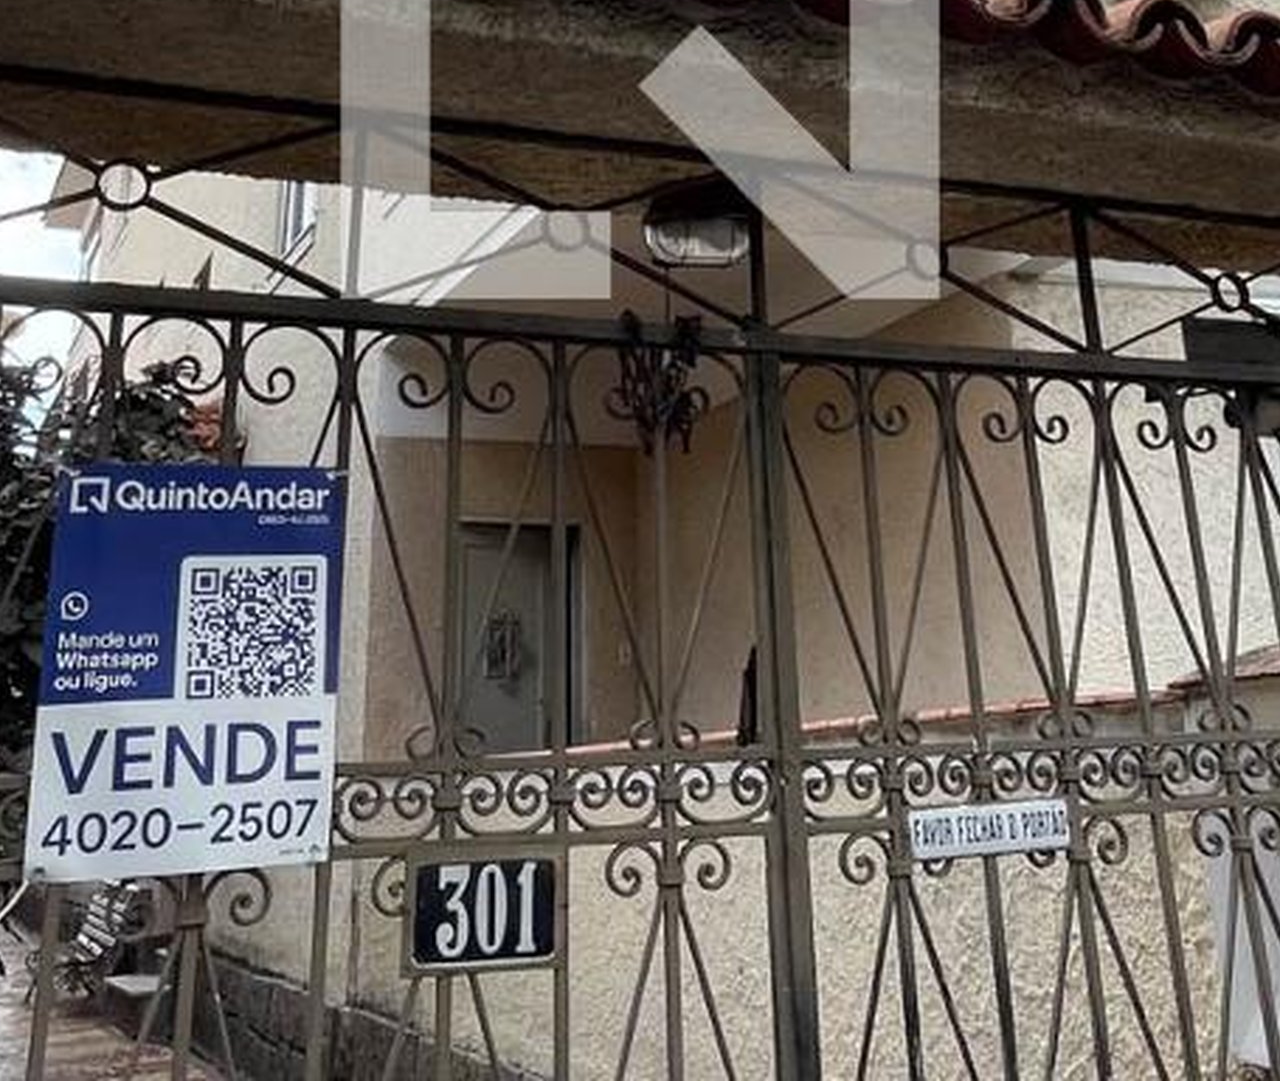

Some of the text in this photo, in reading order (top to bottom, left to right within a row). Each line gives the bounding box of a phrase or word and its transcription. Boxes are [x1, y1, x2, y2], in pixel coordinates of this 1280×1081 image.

[115, 480, 330, 512] QuintoAndar
[58, 630, 159, 650] Mande um
[55, 651, 159, 671] Whatsapp
[53, 671, 138, 694] ou ligue.
[51, 719, 321, 796] VENDE
[41, 798, 319, 857] 4020-2507
[913, 818, 954, 846] FAVOR
[957, 814, 1004, 844] FECHAR
[434, 861, 540, 956] 301
